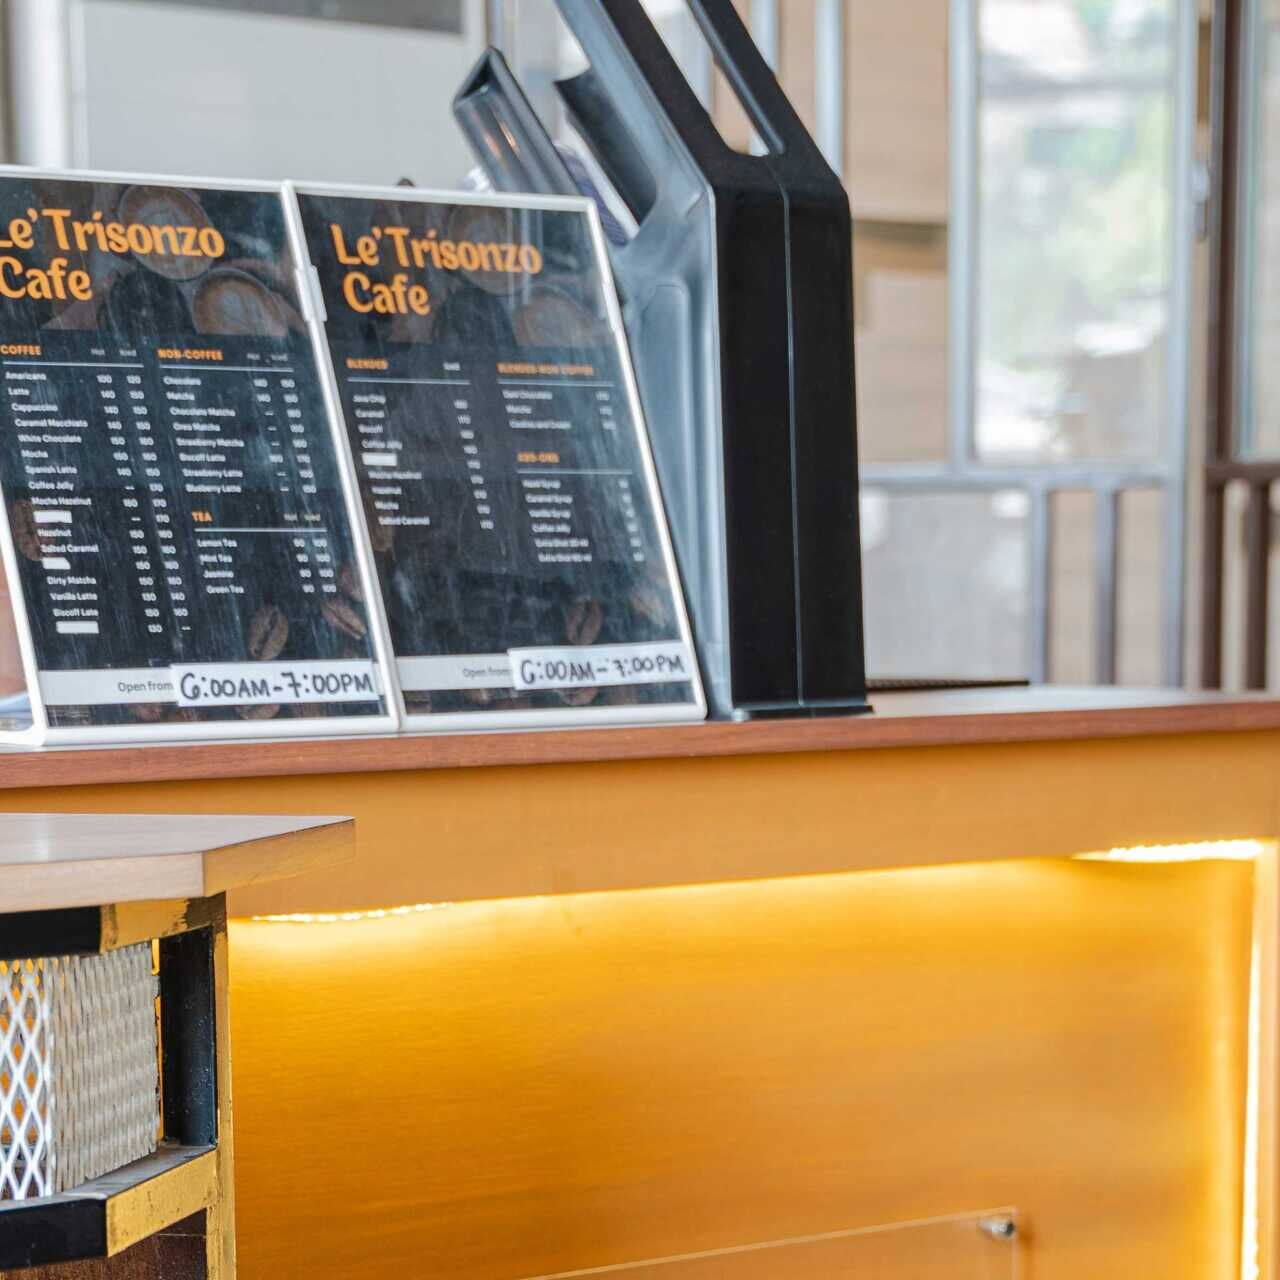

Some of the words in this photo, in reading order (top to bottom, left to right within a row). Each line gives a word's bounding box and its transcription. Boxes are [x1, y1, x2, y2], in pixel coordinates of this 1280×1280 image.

[342, 271, 431, 315] Cafe
[0, 344, 41, 356] COFFEE
[158, 348, 224, 360] NON-COFFEE
[5, 371, 46, 380] Americano
[163, 376, 202, 385] Chocolate
[8, 387, 30, 396] Latte
[100, 390, 116, 399] 140
[166, 391, 195, 400] Matcha
[11, 402, 58, 413] Cappuccino
[104, 405, 119, 414] 140
[169, 407, 208, 416] Chocolate
[207, 408, 236, 417] Matcha
[14, 418, 47, 427] Caramel
[47, 419, 89, 428] Macchiato
[107, 421, 122, 430] 140
[172, 422, 193, 431] Oreo
[192, 422, 221, 431] Matcha
[18, 434, 42, 443] White
[42, 434, 82, 443] Chocolate
[175, 437, 217, 448] Strawberry
[216, 438, 245, 447] Matcha
[21, 449, 48, 458] Mocha
[25, 465, 56, 475] Spanish
[56, 466, 78, 474] Latte
[117, 467, 132, 476] 140
[182, 468, 223, 478] Strawberry
[222, 469, 243, 477] Latte
[28, 481, 55, 490] Coffee
[55, 481, 74, 491] Jelly
[221, 484, 242, 492] Latte
[31, 497, 59, 505] Mocha
[59, 498, 92, 506] Hazelnut
[152, 499, 167, 507] 170
[191, 511, 213, 522] TEA
[37, 529, 72, 537] Hazelnut
[196, 539, 222, 547] Lemon
[222, 538, 238, 547] Tea
[40, 544, 67, 552] Salted
[67, 544, 99, 552] Caramel
[217, 554, 233, 563] Tea
[203, 570, 235, 578] Jasmine
[46, 576, 67, 586] Dirty
[67, 577, 97, 585] Matcha
[206, 585, 230, 594] Green
[229, 585, 245, 594] Tea
[50, 592, 76, 600] Vanilla
[53, 608, 80, 616] Biscoff
[462, 667, 487, 678] Open
[118, 681, 146, 693] Open
[148, 680, 173, 691] from
